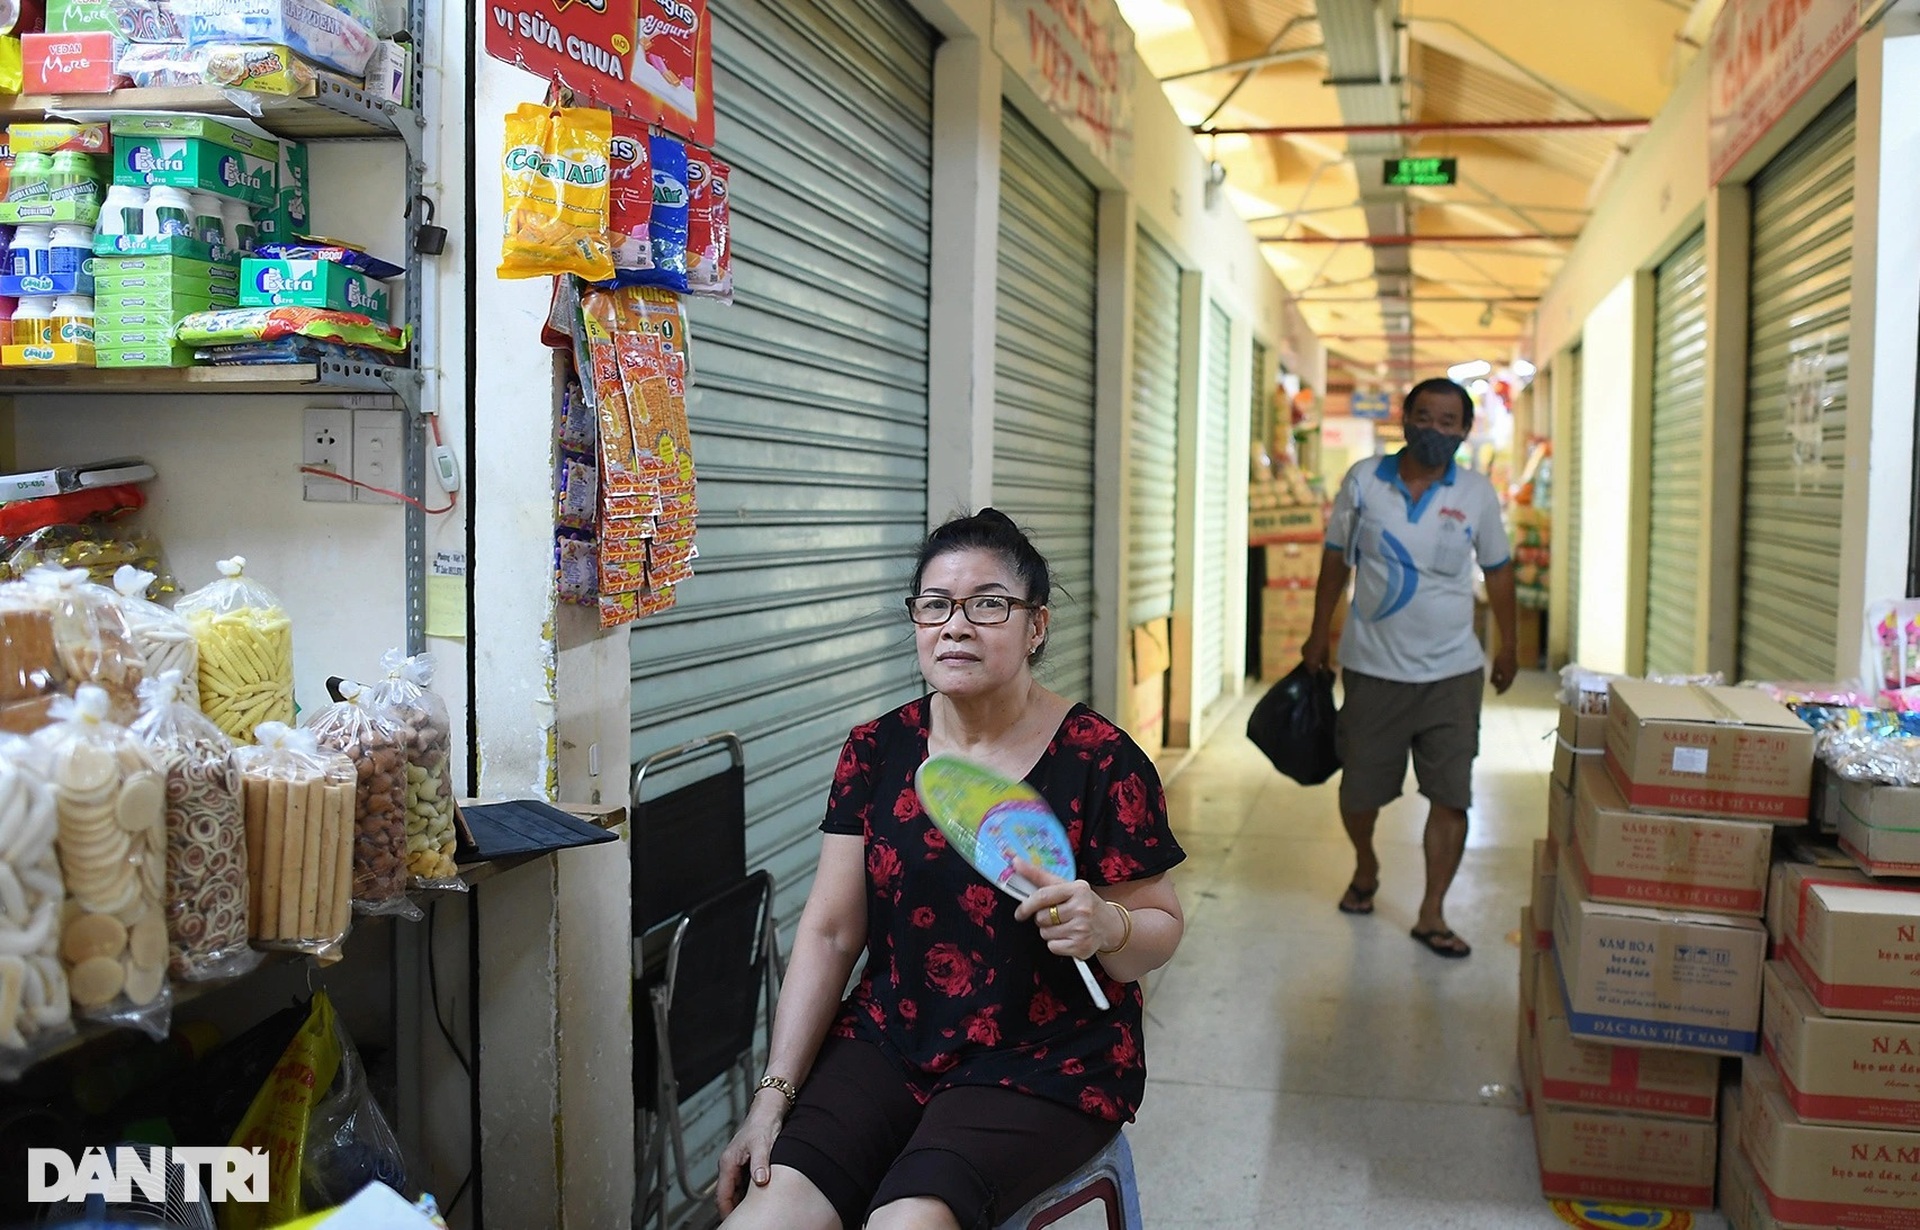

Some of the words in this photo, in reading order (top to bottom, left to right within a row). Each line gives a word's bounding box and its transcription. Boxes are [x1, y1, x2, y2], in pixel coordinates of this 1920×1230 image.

[644, 15, 691, 40] Yogurt
[49, 43, 83, 55] VEDAN
[493, 6, 514, 37] VỊ
[518, 10, 563, 53] SỮA
[566, 34, 625, 81] CHUA
[135, 149, 183, 171] Extra
[505, 148, 566, 179] Cool
[567, 163, 608, 185] Air
[225, 160, 260, 189] Extra
[263, 271, 313, 292] Extra
[349, 283, 378, 311] Extra
[1598, 938, 1626, 951] NAM
[1698, 1032, 1729, 1046] NAM
[1872, 1036, 1920, 1056] NA
[1851, 1143, 1920, 1163] NAM
